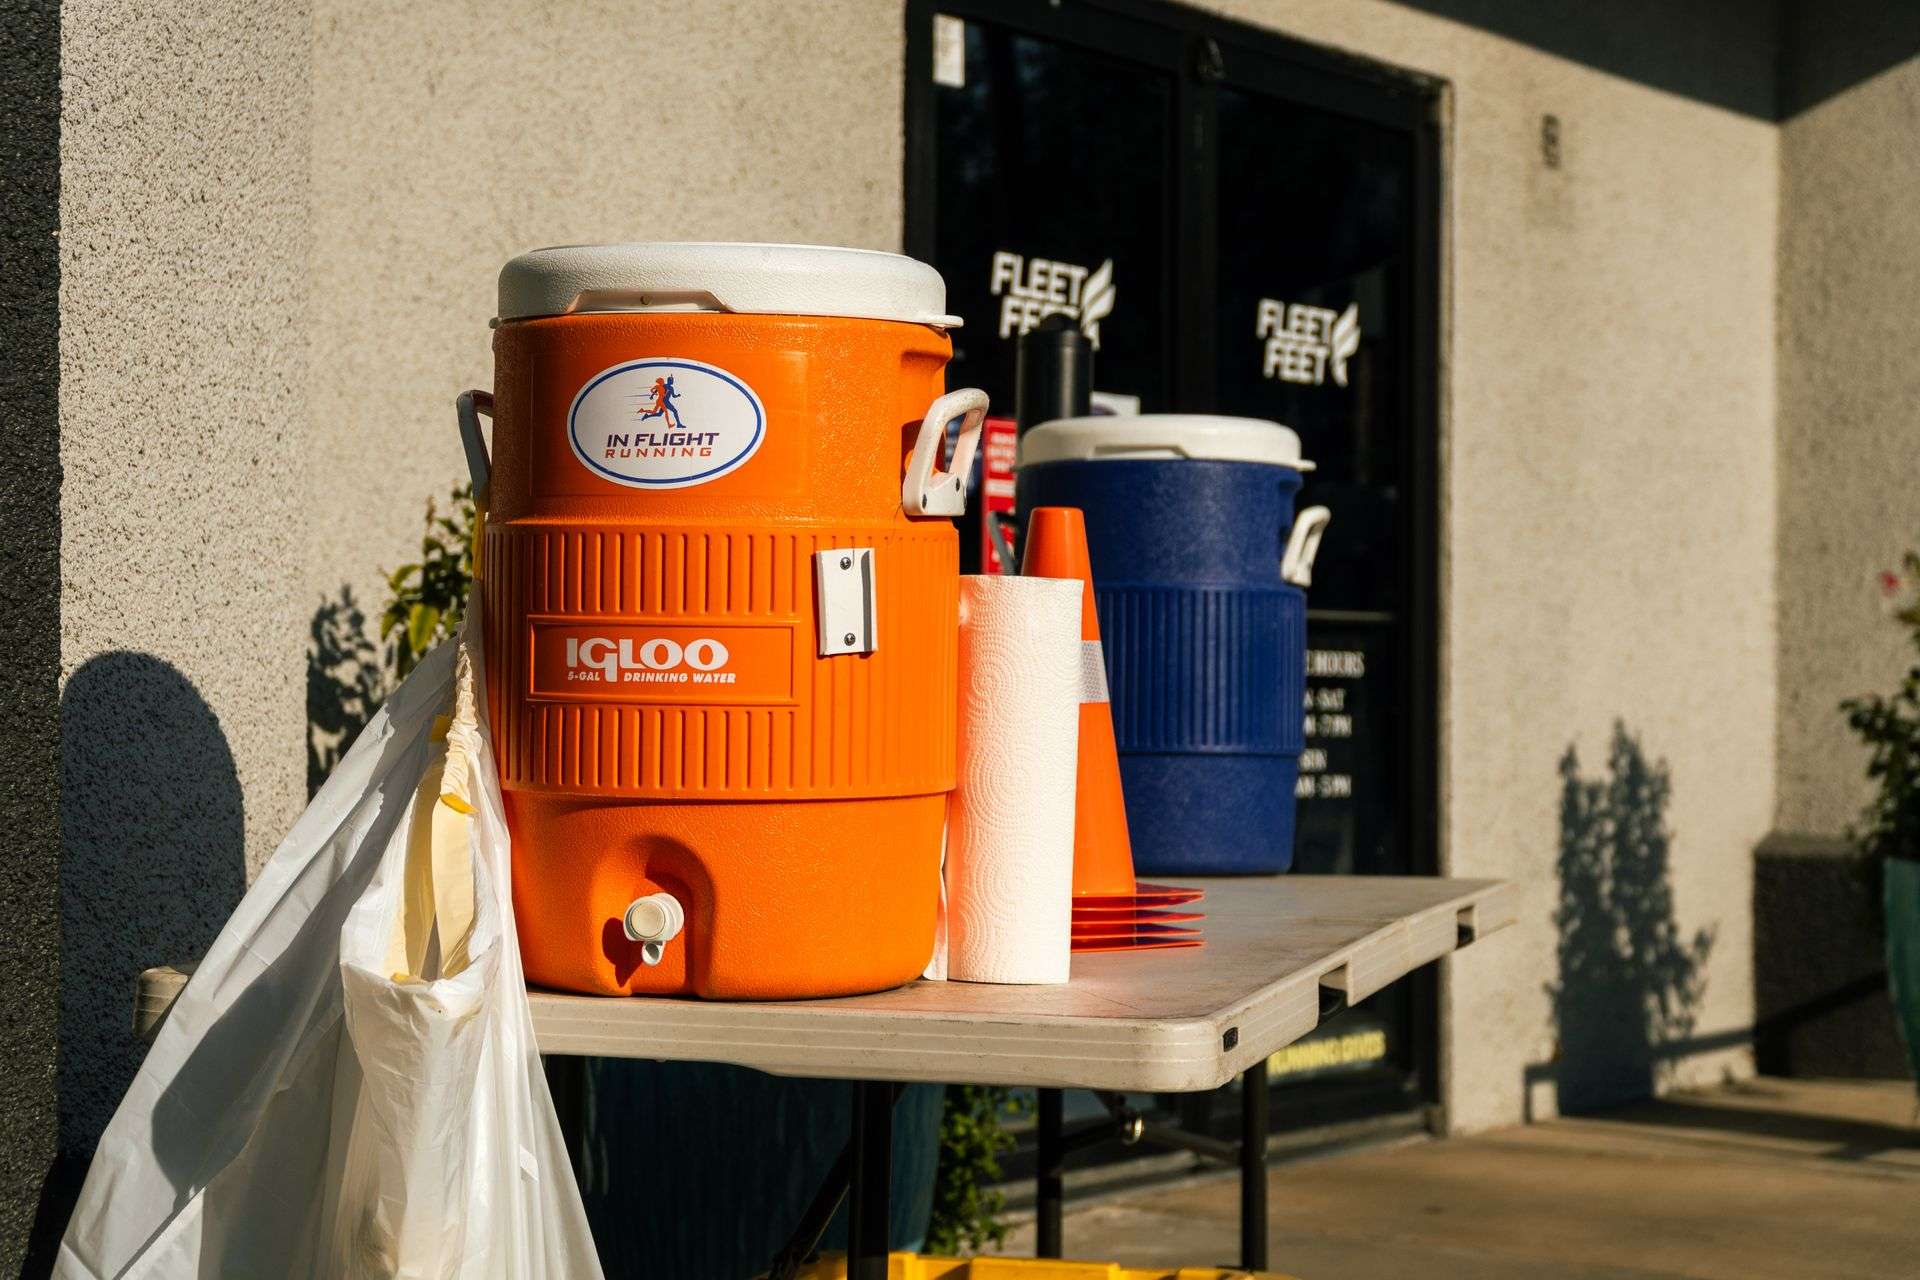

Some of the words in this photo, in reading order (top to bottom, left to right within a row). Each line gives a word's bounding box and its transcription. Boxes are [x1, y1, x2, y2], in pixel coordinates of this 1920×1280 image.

[991, 251, 1088, 305] FLEET
[1000, 296, 1080, 339] FE
[1256, 298, 1338, 345] FLEET
[1263, 338, 1328, 386] FEET
[604, 447, 713, 459] RUNNING
[606, 433, 629, 448] IN
[634, 432, 720, 447] FLIGHT
[566, 637, 729, 682] IGLOO
[567, 671, 601, 681] 5-GAL
[624, 672, 688, 683] DRINKING
[692, 673, 736, 684] WATER
